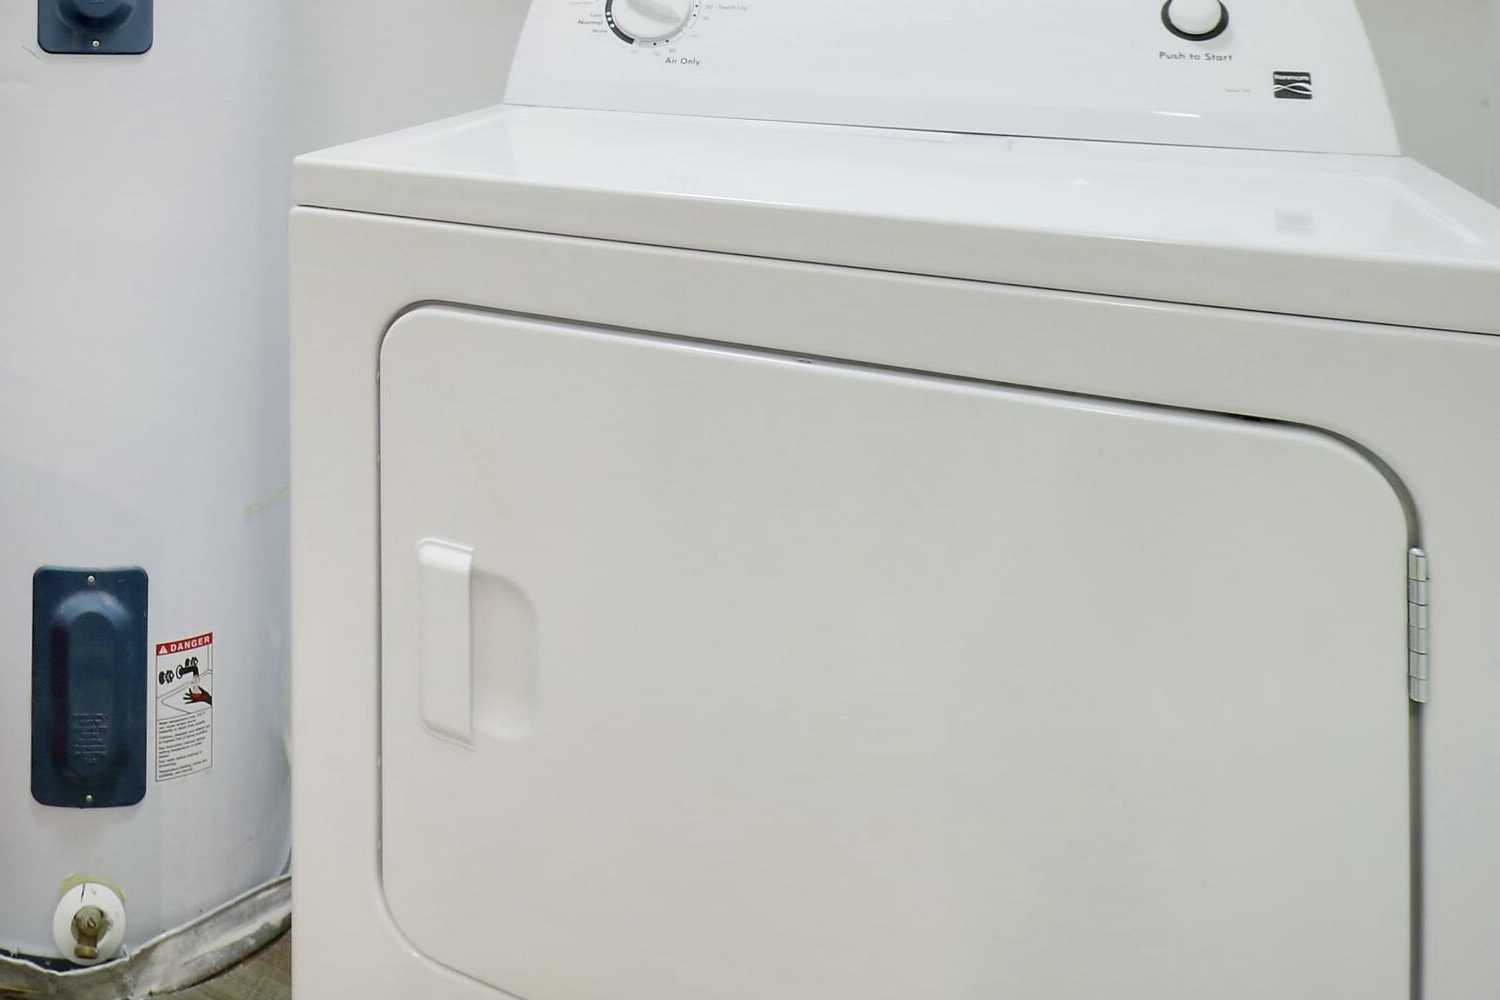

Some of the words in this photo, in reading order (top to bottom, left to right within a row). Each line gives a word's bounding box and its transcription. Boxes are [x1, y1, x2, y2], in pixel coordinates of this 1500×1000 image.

[665, 56, 679, 65] Air
[680, 56, 701, 66] Only
[1158, 51, 1186, 61] Push
[1189, 51, 1201, 61] to
[1204, 52, 1233, 62] Start
[169, 635, 211, 653] DANGER
